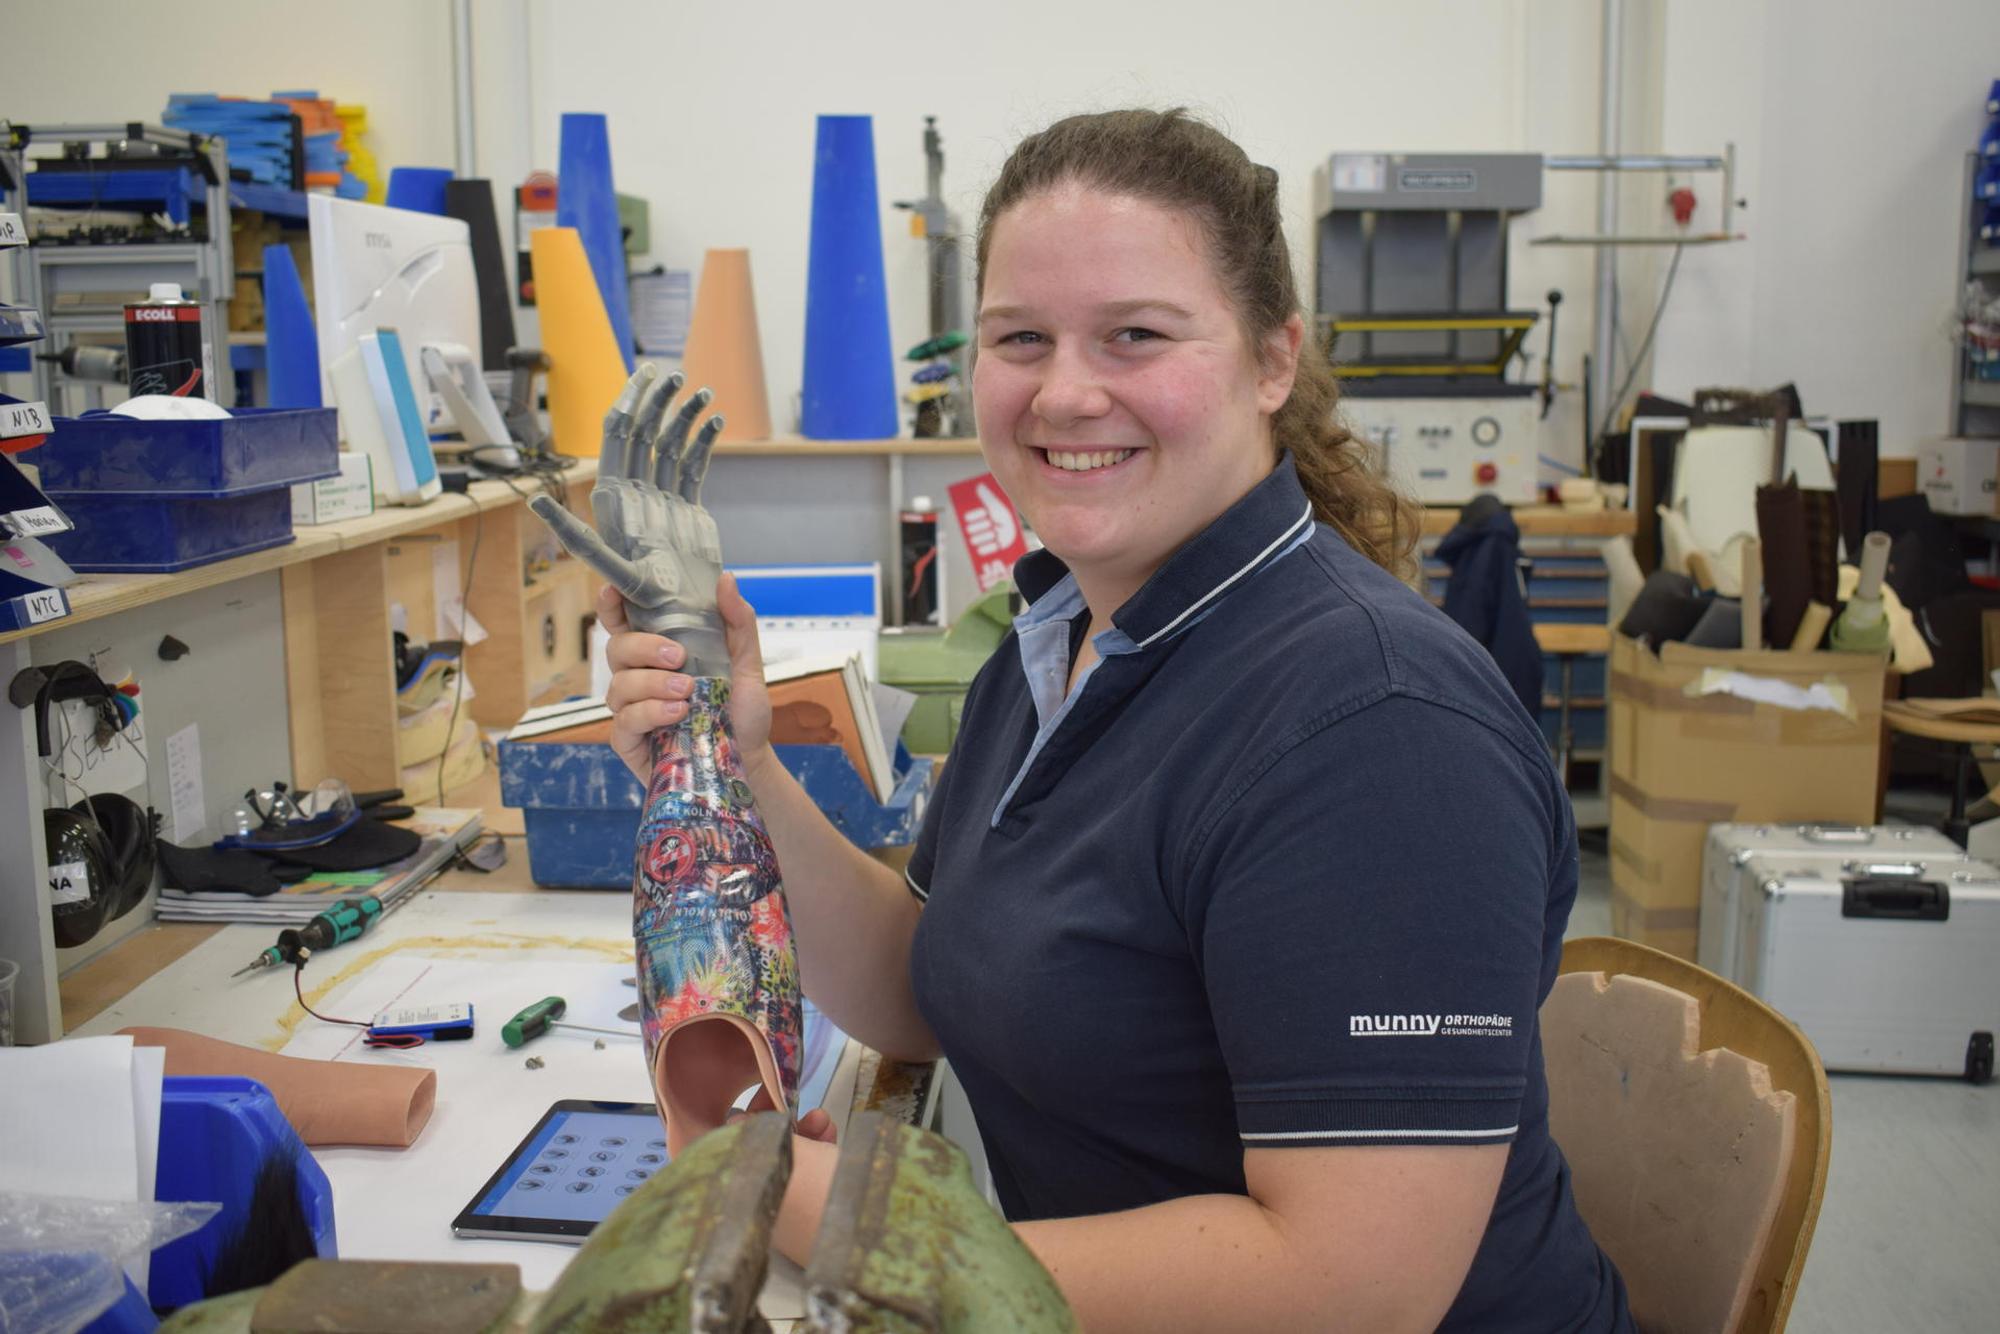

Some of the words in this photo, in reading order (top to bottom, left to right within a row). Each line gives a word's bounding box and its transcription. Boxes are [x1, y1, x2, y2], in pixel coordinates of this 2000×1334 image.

[31, 596, 58, 616] NTC
[1350, 1014, 1441, 1036] munny
[1444, 1013, 1512, 1027] ORTHOPÄDIE
[1441, 1027, 1512, 1037] GESUNDHEITSCENTER
